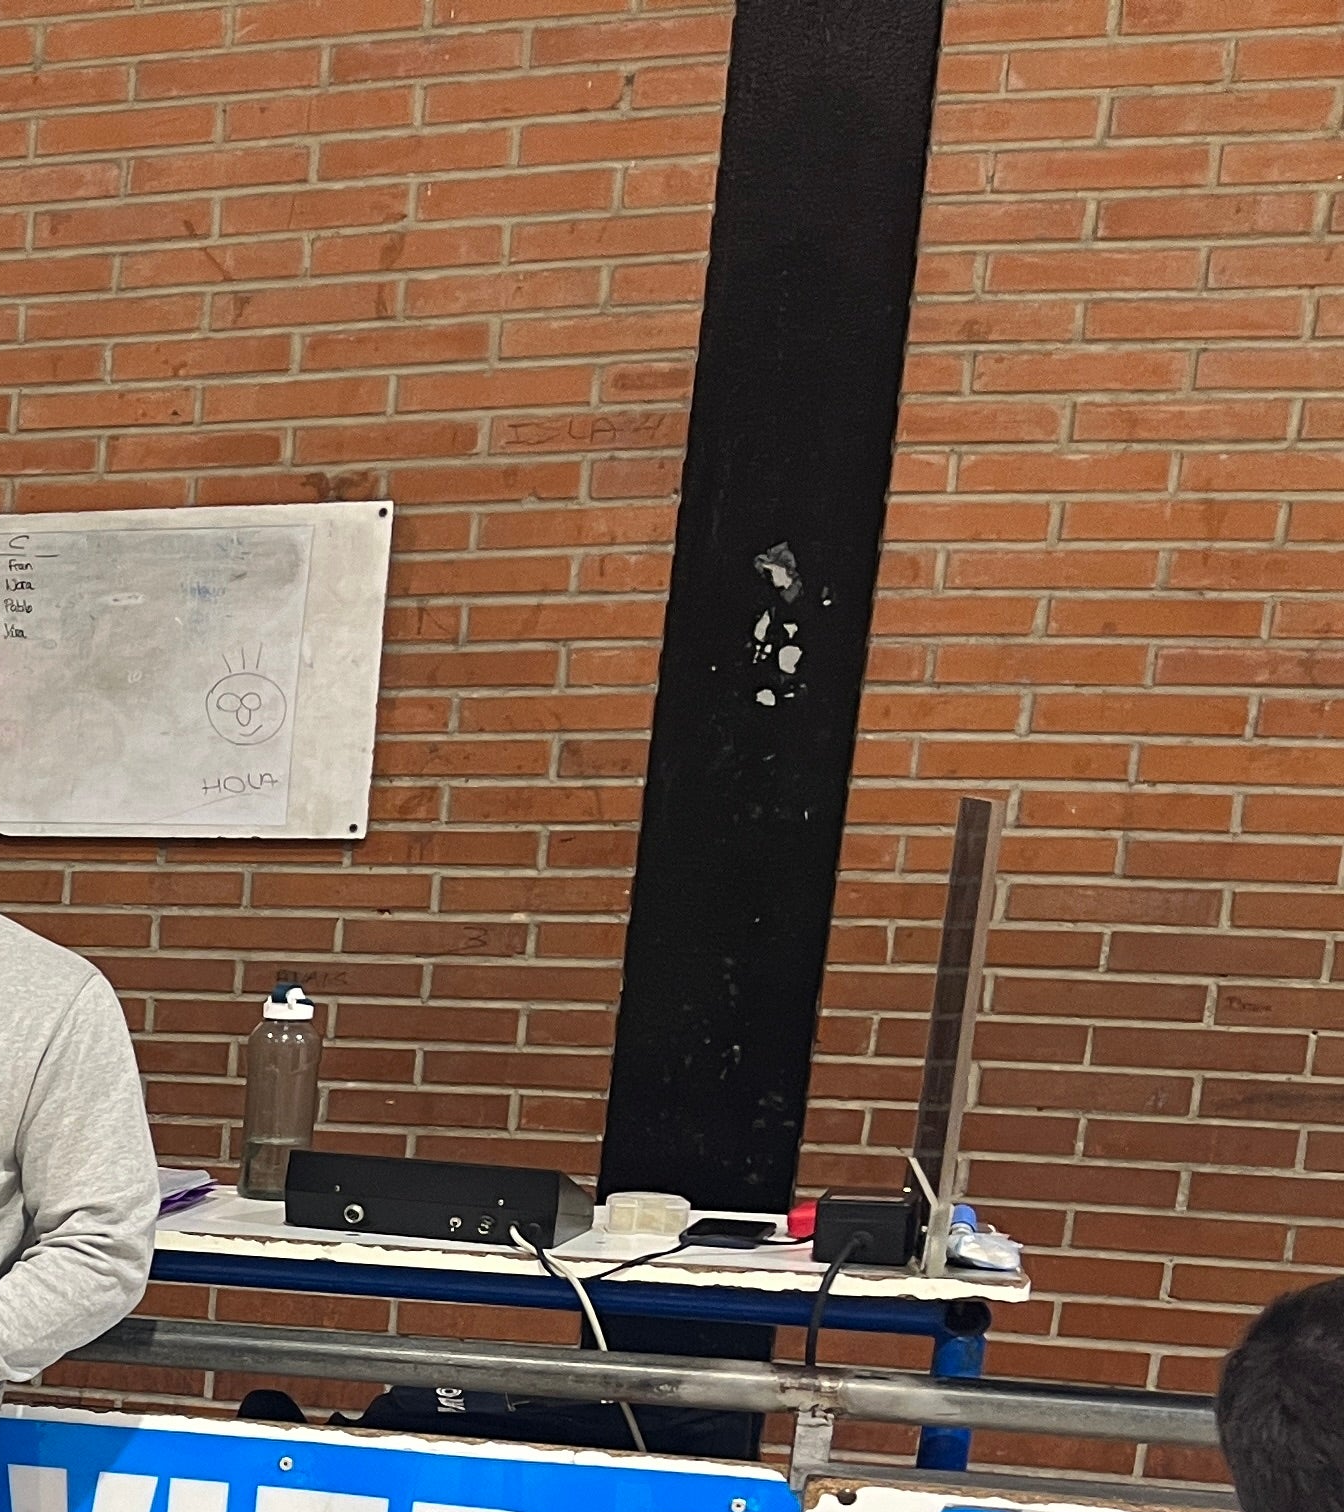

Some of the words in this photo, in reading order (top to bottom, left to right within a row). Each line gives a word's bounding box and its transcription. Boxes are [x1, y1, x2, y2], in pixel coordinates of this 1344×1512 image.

[9, 535, 30, 549] C
[8, 559, 33, 571] Fran
[4, 598, 33, 613] Pablo
[202, 773, 279, 795] HOLA
